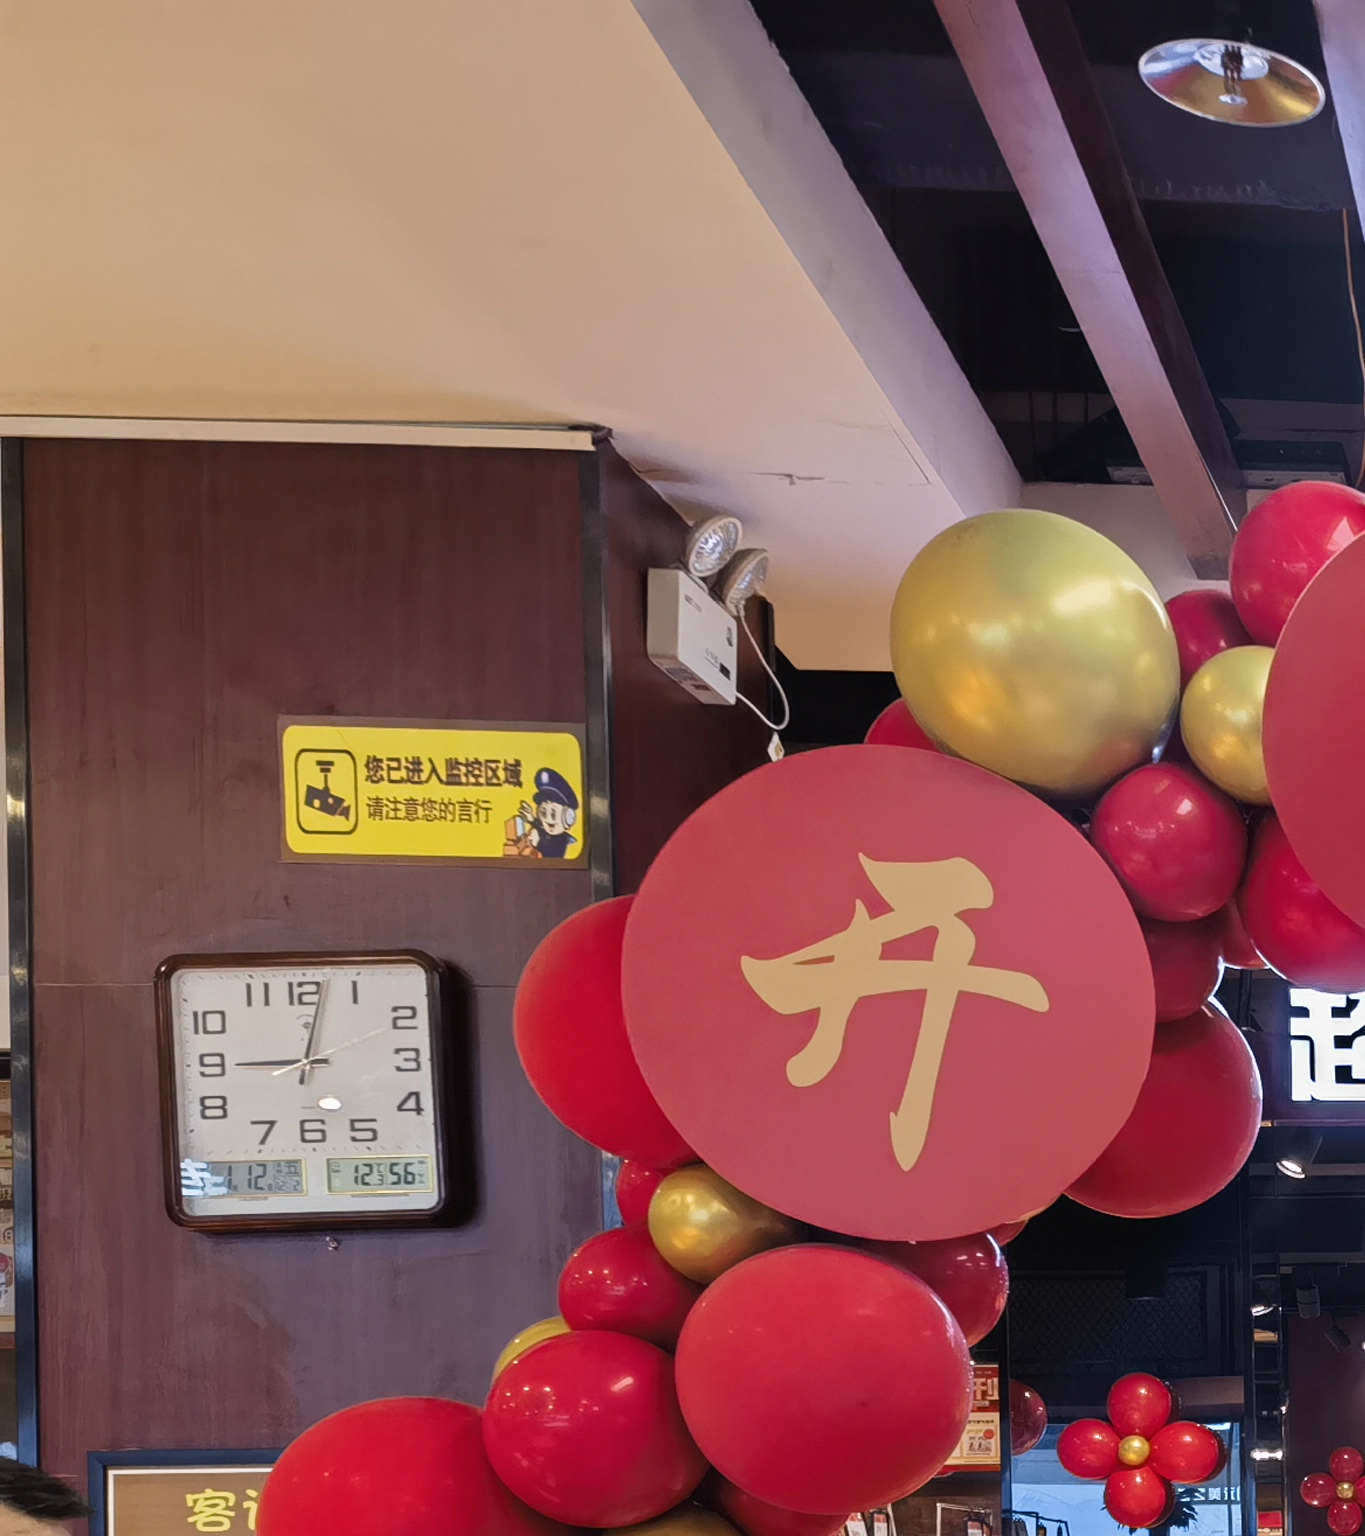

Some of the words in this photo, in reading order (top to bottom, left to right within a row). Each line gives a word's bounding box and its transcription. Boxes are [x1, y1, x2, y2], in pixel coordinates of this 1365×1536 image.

[364, 755, 522, 789] 您已进入监控区域
[366, 796, 494, 824] 请注意您的言行
[246, 982, 270, 1007] 11
[288, 981, 322, 1006] 12
[352, 980, 359, 1004] 1
[193, 1010, 226, 1034] 10
[391, 1006, 418, 1029] 2
[740, 851, 1050, 1172] 开
[199, 1053, 225, 1077] 9
[394, 1048, 421, 1072] 3
[200, 1096, 227, 1119] 8
[396, 1092, 424, 1115] 4
[250, 1121, 278, 1145] 7
[300, 1119, 326, 1143] 6
[349, 1118, 378, 1142] 5
